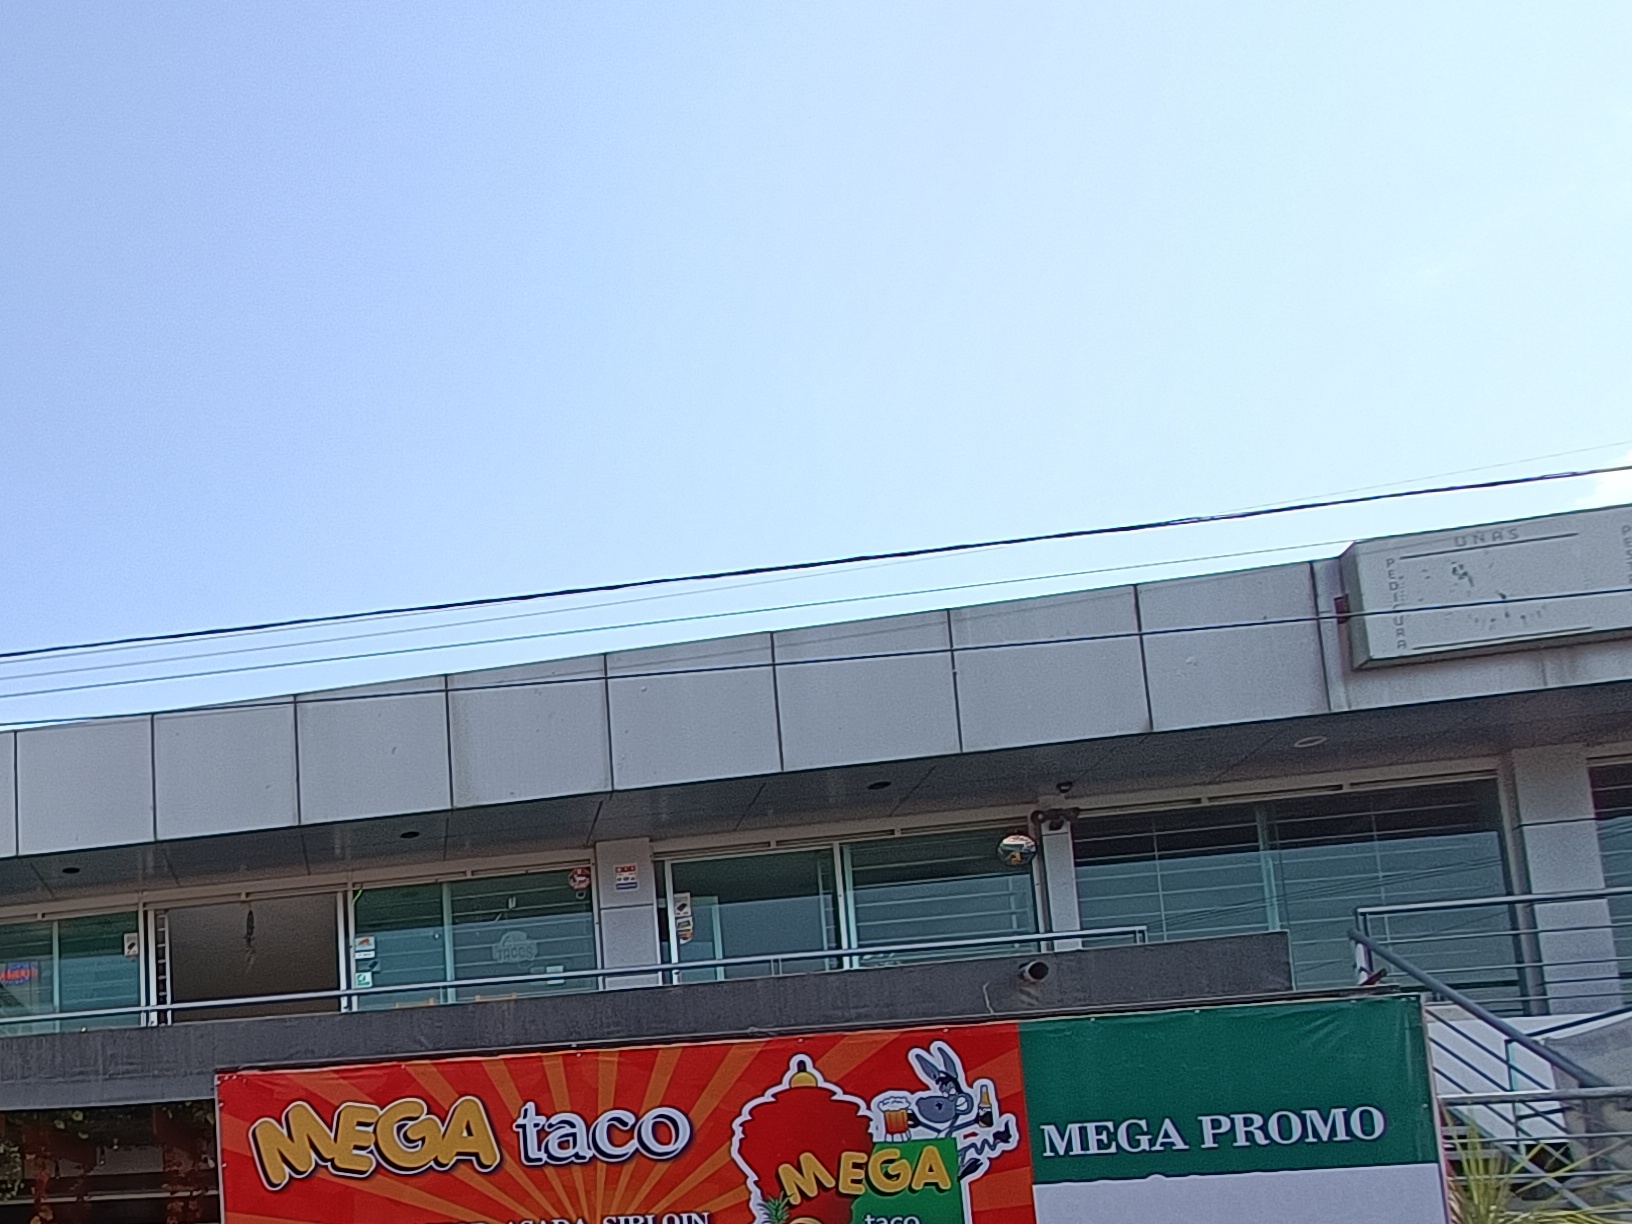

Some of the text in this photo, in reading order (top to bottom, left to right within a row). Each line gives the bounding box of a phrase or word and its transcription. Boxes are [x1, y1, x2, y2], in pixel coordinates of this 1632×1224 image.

[249, 1096, 691, 1191] MEGA taco
[1039, 1106, 1386, 1157] MEGA PROMO
[778, 1145, 952, 1206] MEGA
